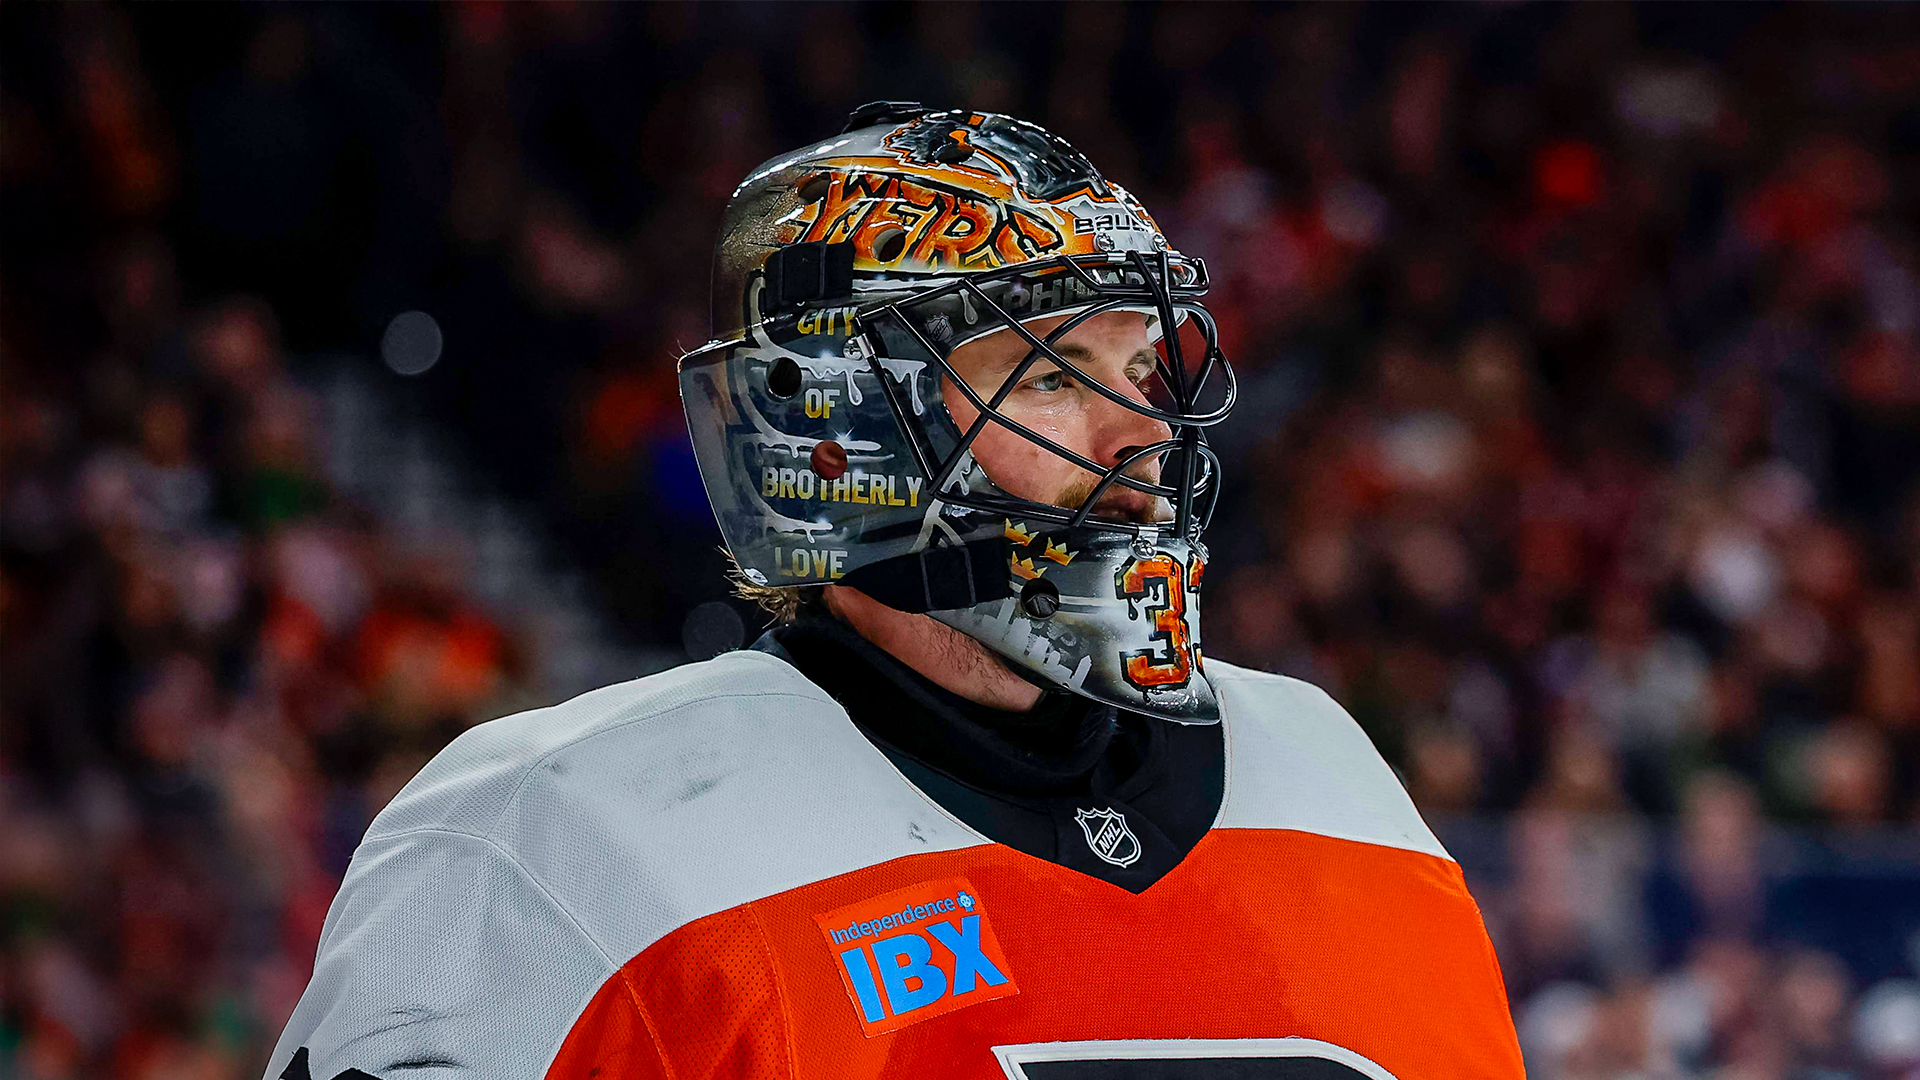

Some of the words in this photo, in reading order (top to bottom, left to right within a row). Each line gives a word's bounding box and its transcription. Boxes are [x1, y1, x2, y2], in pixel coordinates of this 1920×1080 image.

[797, 306, 858, 336] CITY
[804, 388, 841, 419] OF
[761, 466, 923, 507] BROTHERLY
[774, 546, 848, 579] LOVE
[1098, 822, 1121, 854] NHL
[829, 897, 956, 945] Independence
[840, 914, 1009, 1023] IBX
